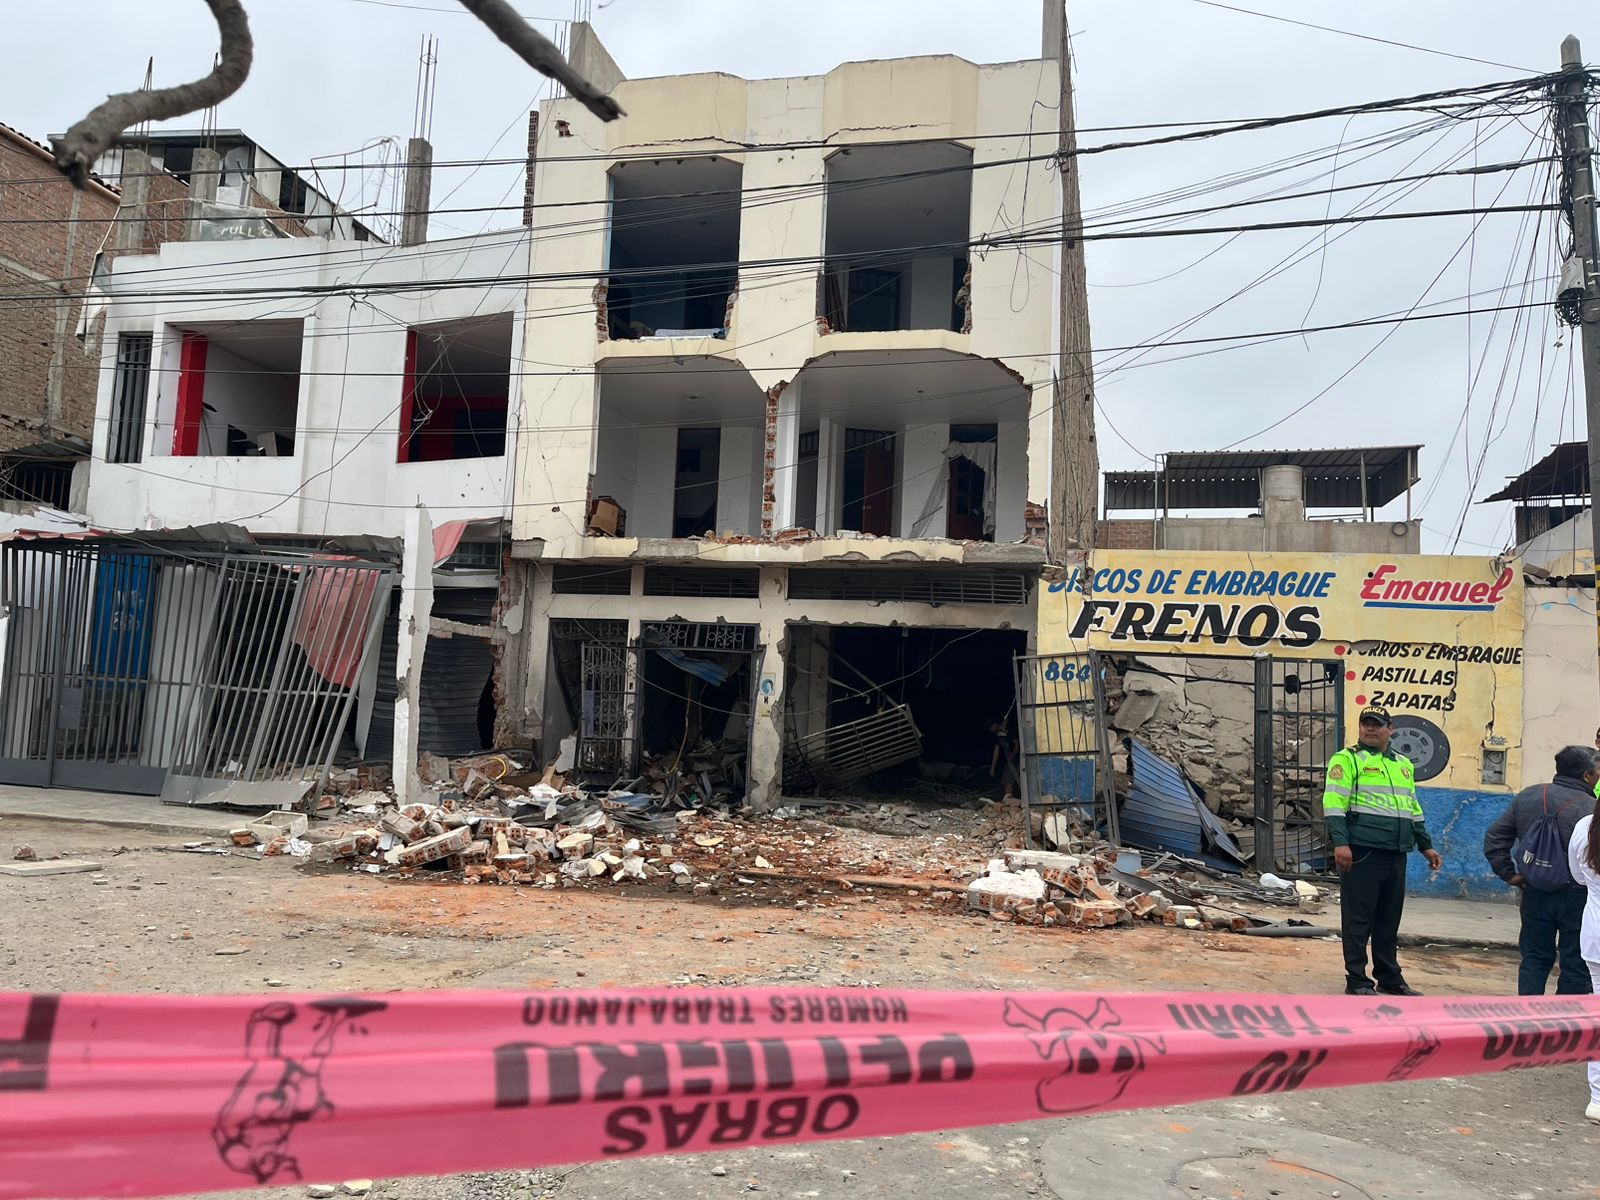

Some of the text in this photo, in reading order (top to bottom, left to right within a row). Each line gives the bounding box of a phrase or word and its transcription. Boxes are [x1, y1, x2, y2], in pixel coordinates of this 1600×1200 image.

[1145, 568, 1183, 595] DE
[1184, 569, 1337, 598] EMBRAGUE
[1359, 564, 1514, 604] Emanuel
[1068, 600, 1322, 648] FRENOS
[1347, 642, 1412, 658] RROS
[1425, 643, 1523, 665] EMBRAGUE
[1044, 661, 1092, 683] 864
[1361, 666, 1457, 687] PASTILLAS
[1369, 690, 1456, 712] ZAPATAS
[521, 995, 910, 1027] HOMBRES TRABAJANDO
[1230, 1049, 1329, 1096] NO
[601, 1094, 861, 1156] OBRAS
